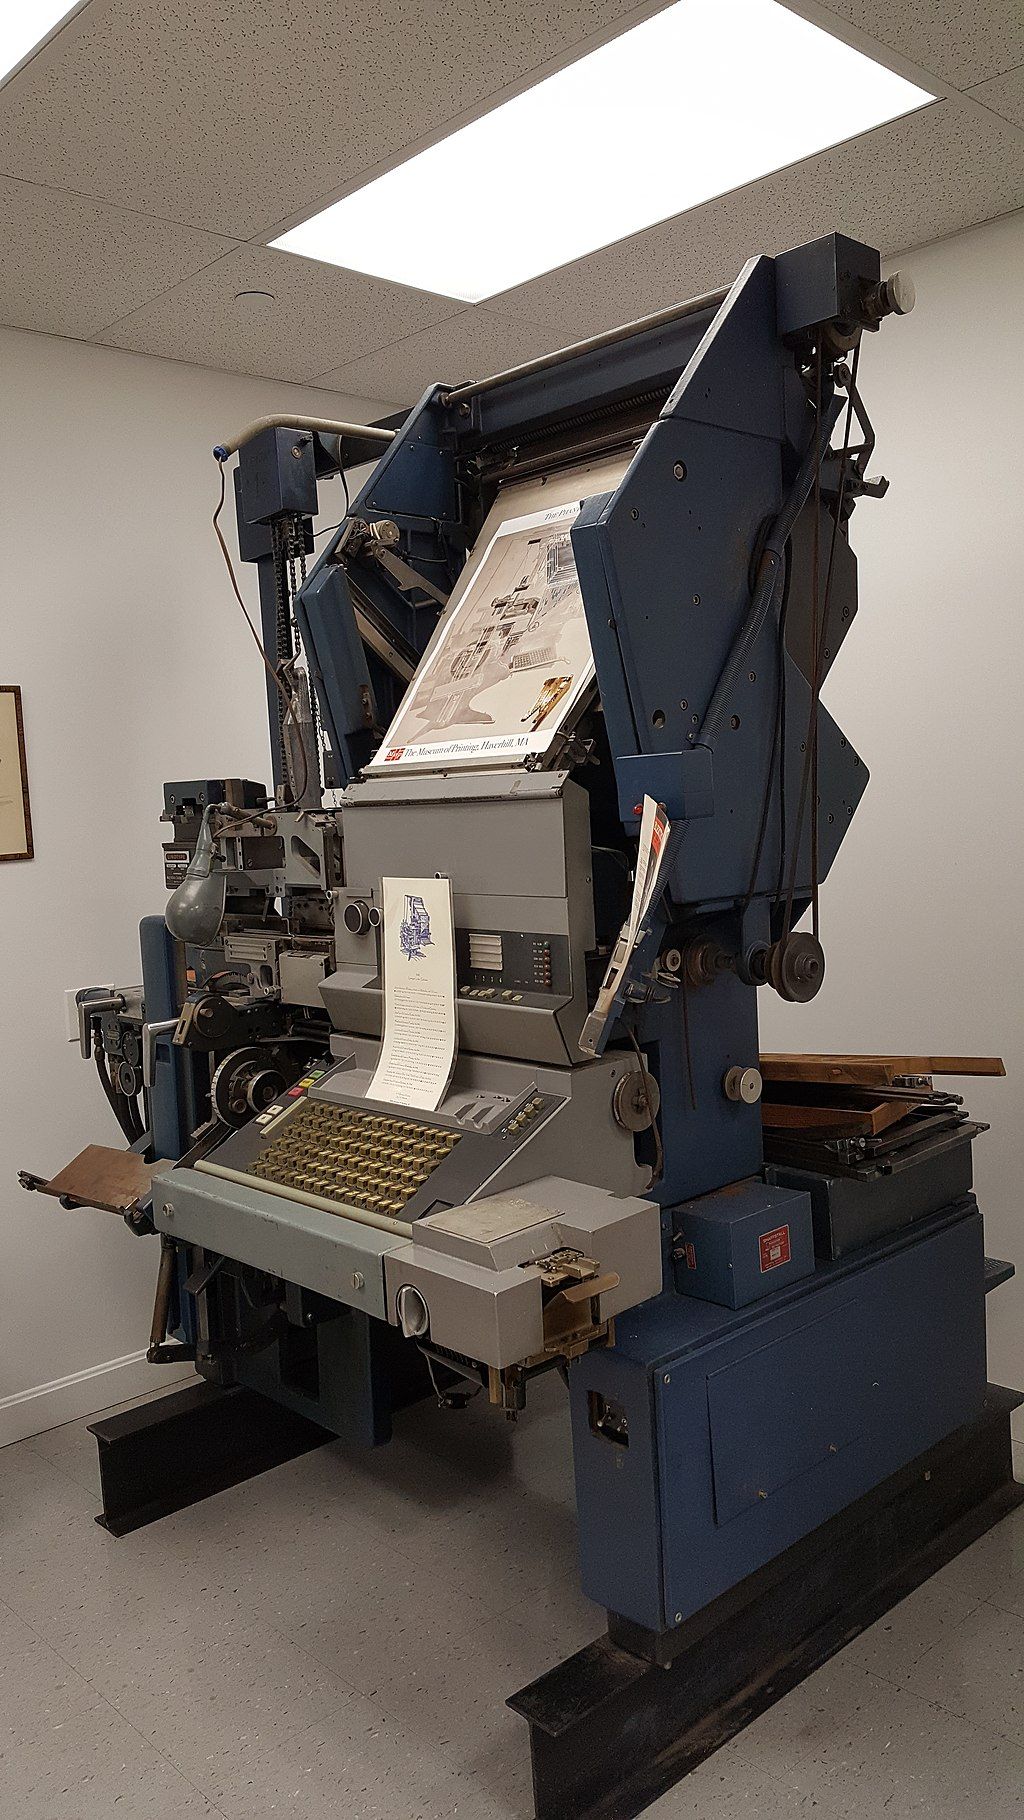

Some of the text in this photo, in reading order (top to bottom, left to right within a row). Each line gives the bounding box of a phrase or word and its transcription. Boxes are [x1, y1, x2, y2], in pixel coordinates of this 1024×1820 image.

[404, 748, 419, 757] The
[419, 747, 443, 756] Museum
[480, 738, 517, 750] Haverhill,
[517, 737, 529, 746] MA
